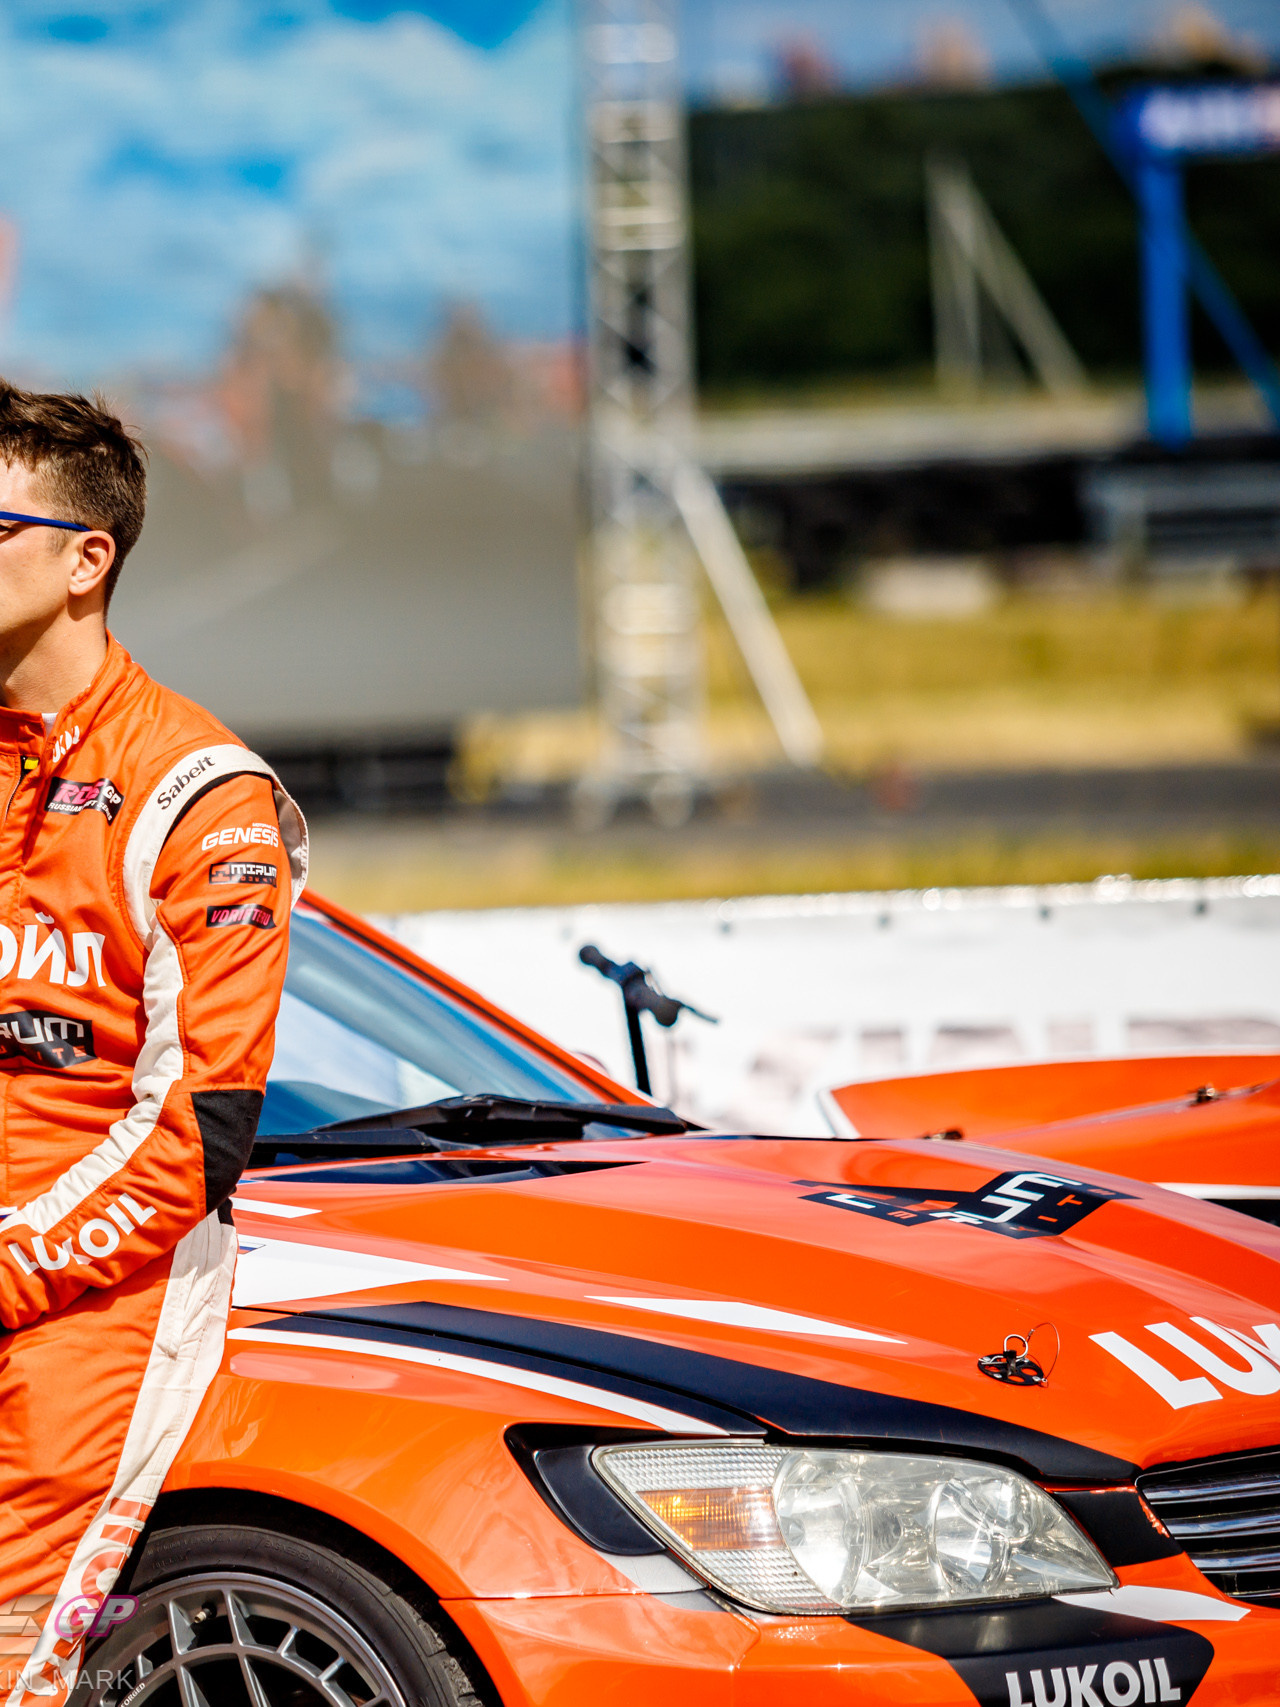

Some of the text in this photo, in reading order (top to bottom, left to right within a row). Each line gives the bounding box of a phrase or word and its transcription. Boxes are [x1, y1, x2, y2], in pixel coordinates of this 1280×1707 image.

[102, 785, 122, 805] GP
[157, 755, 215, 810] Sabelt
[201, 827, 279, 851] GENESIS
[1005, 1657, 1181, 1707] LUKOIL
